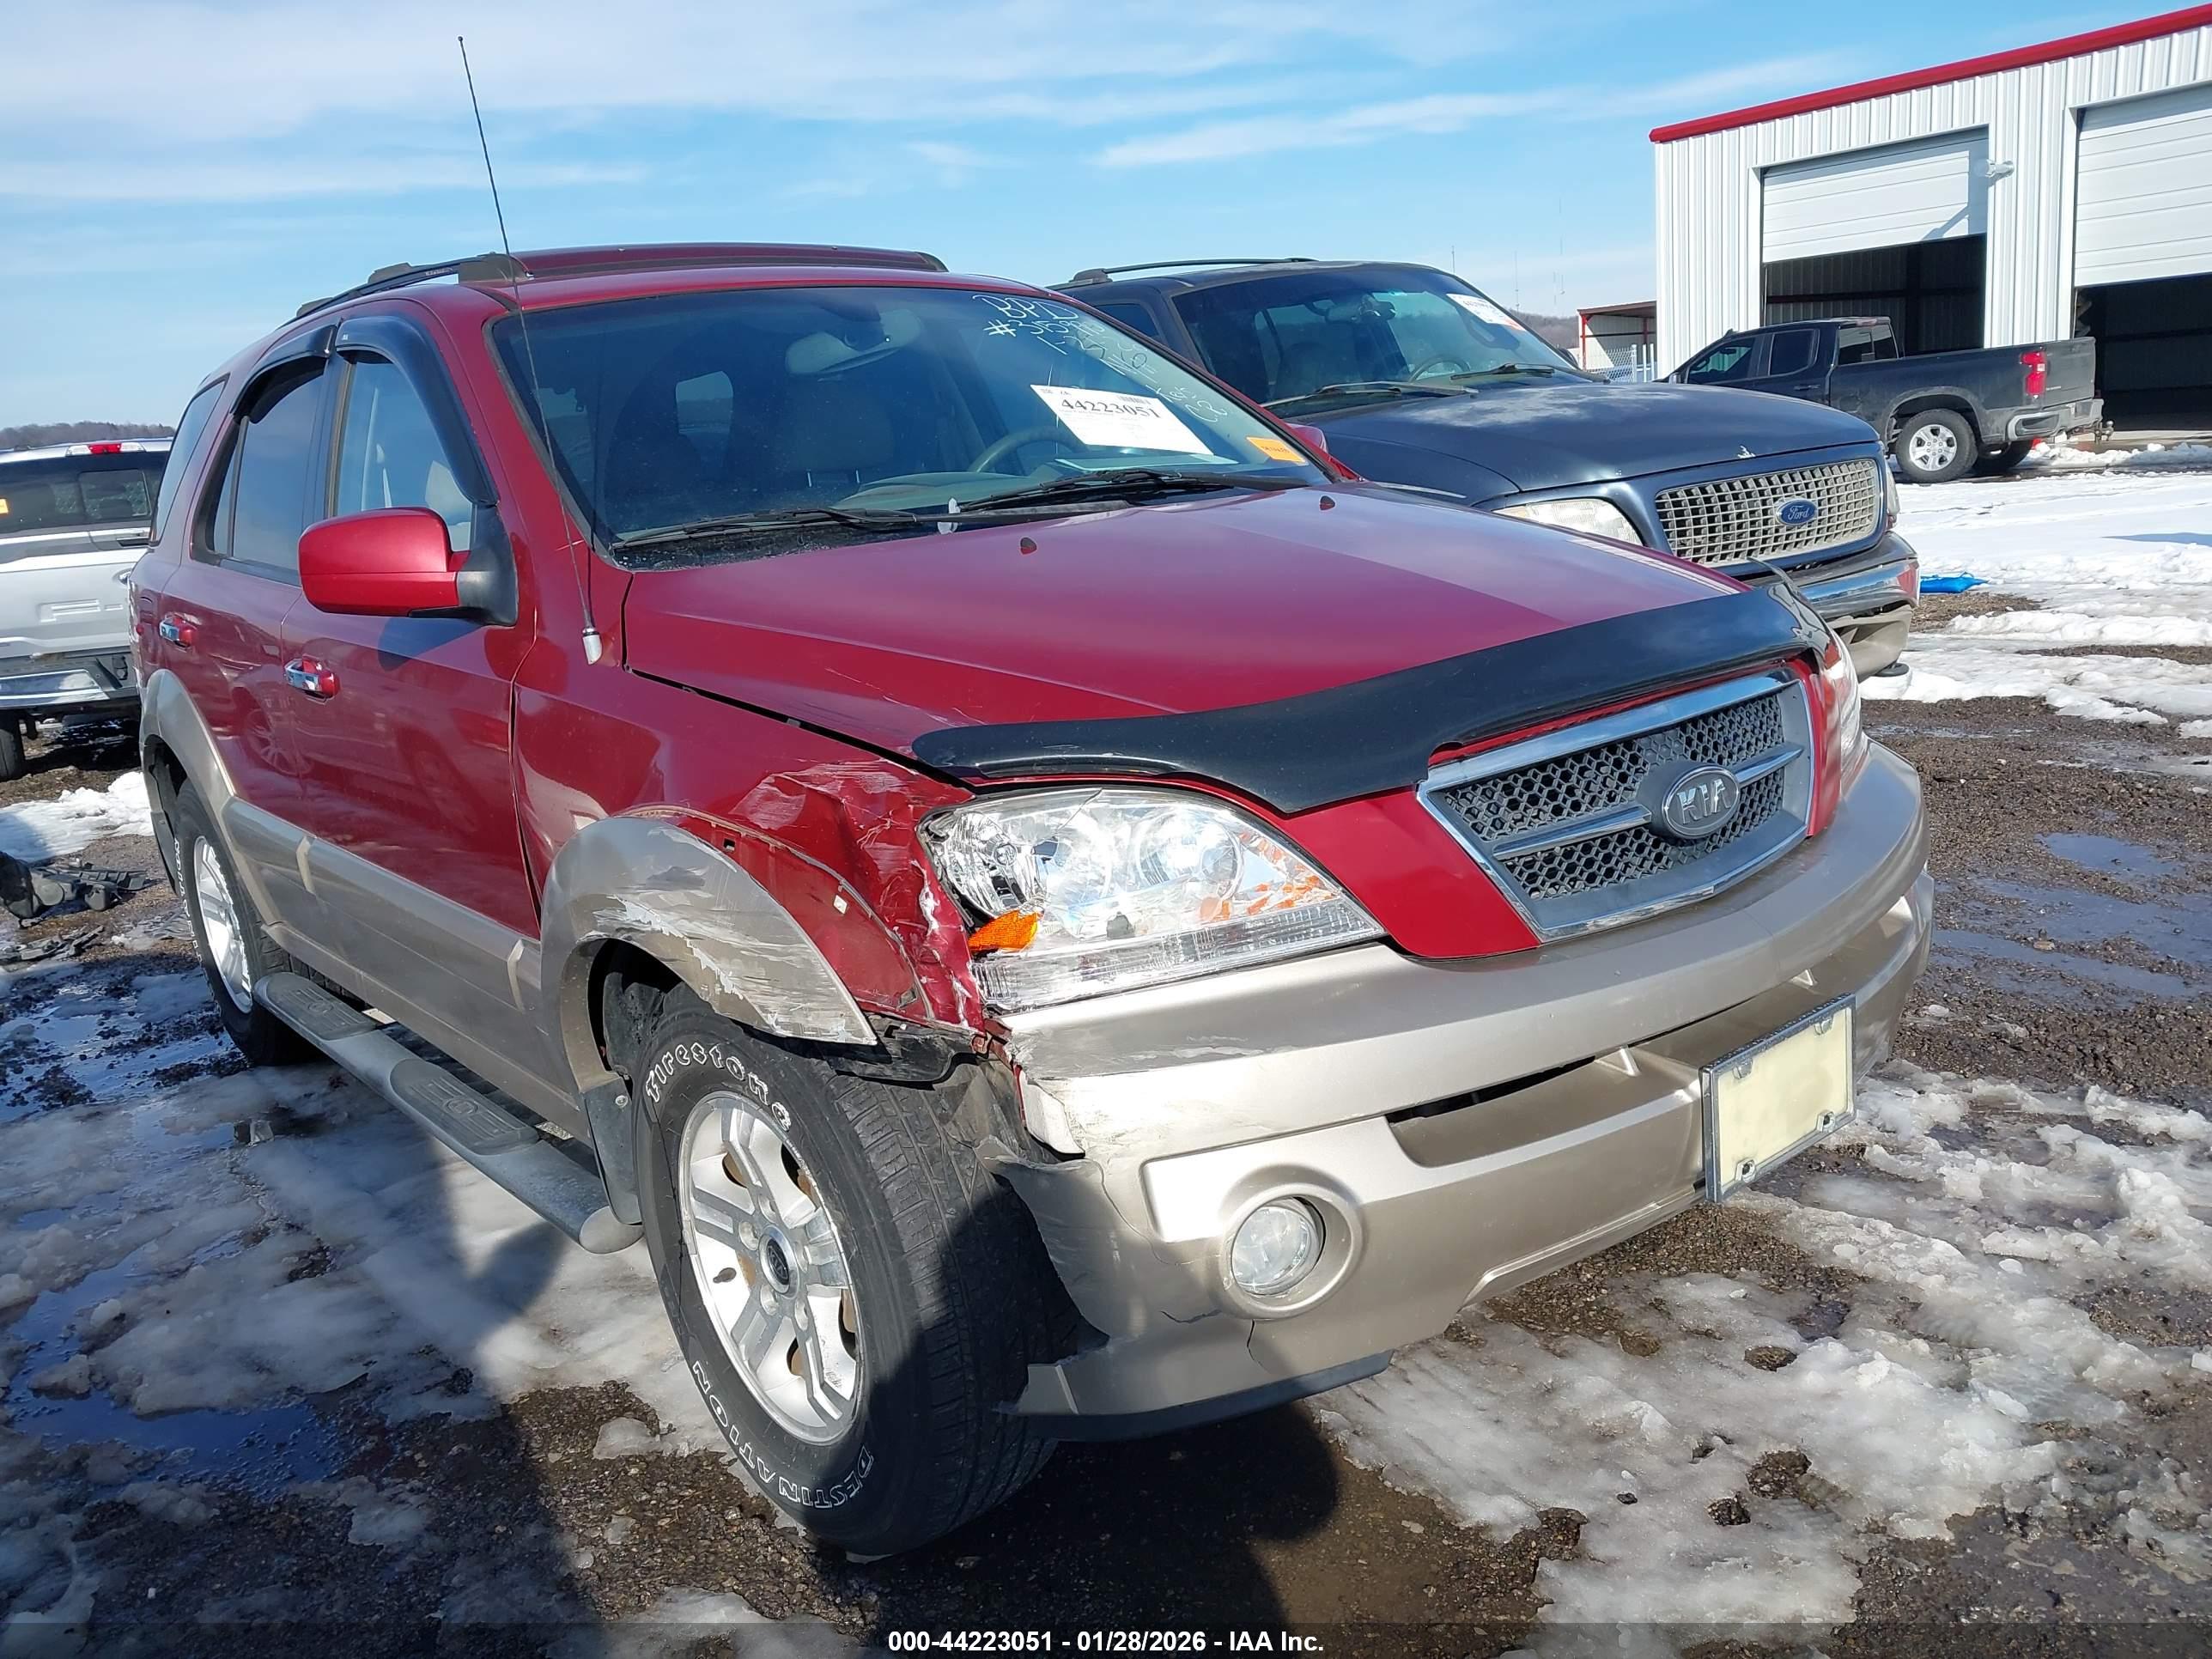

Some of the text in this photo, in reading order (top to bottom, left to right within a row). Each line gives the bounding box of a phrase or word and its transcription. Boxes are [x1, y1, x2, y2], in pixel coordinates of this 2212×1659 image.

[972, 295, 1079, 319] BPD
[1060, 398, 1161, 418] 44223051
[1787, 505, 1811, 520] Ford
[1676, 778, 1733, 825] KIA
[645, 1042, 792, 1132] Firestone
[691, 1360, 875, 1509] DESTINATION
